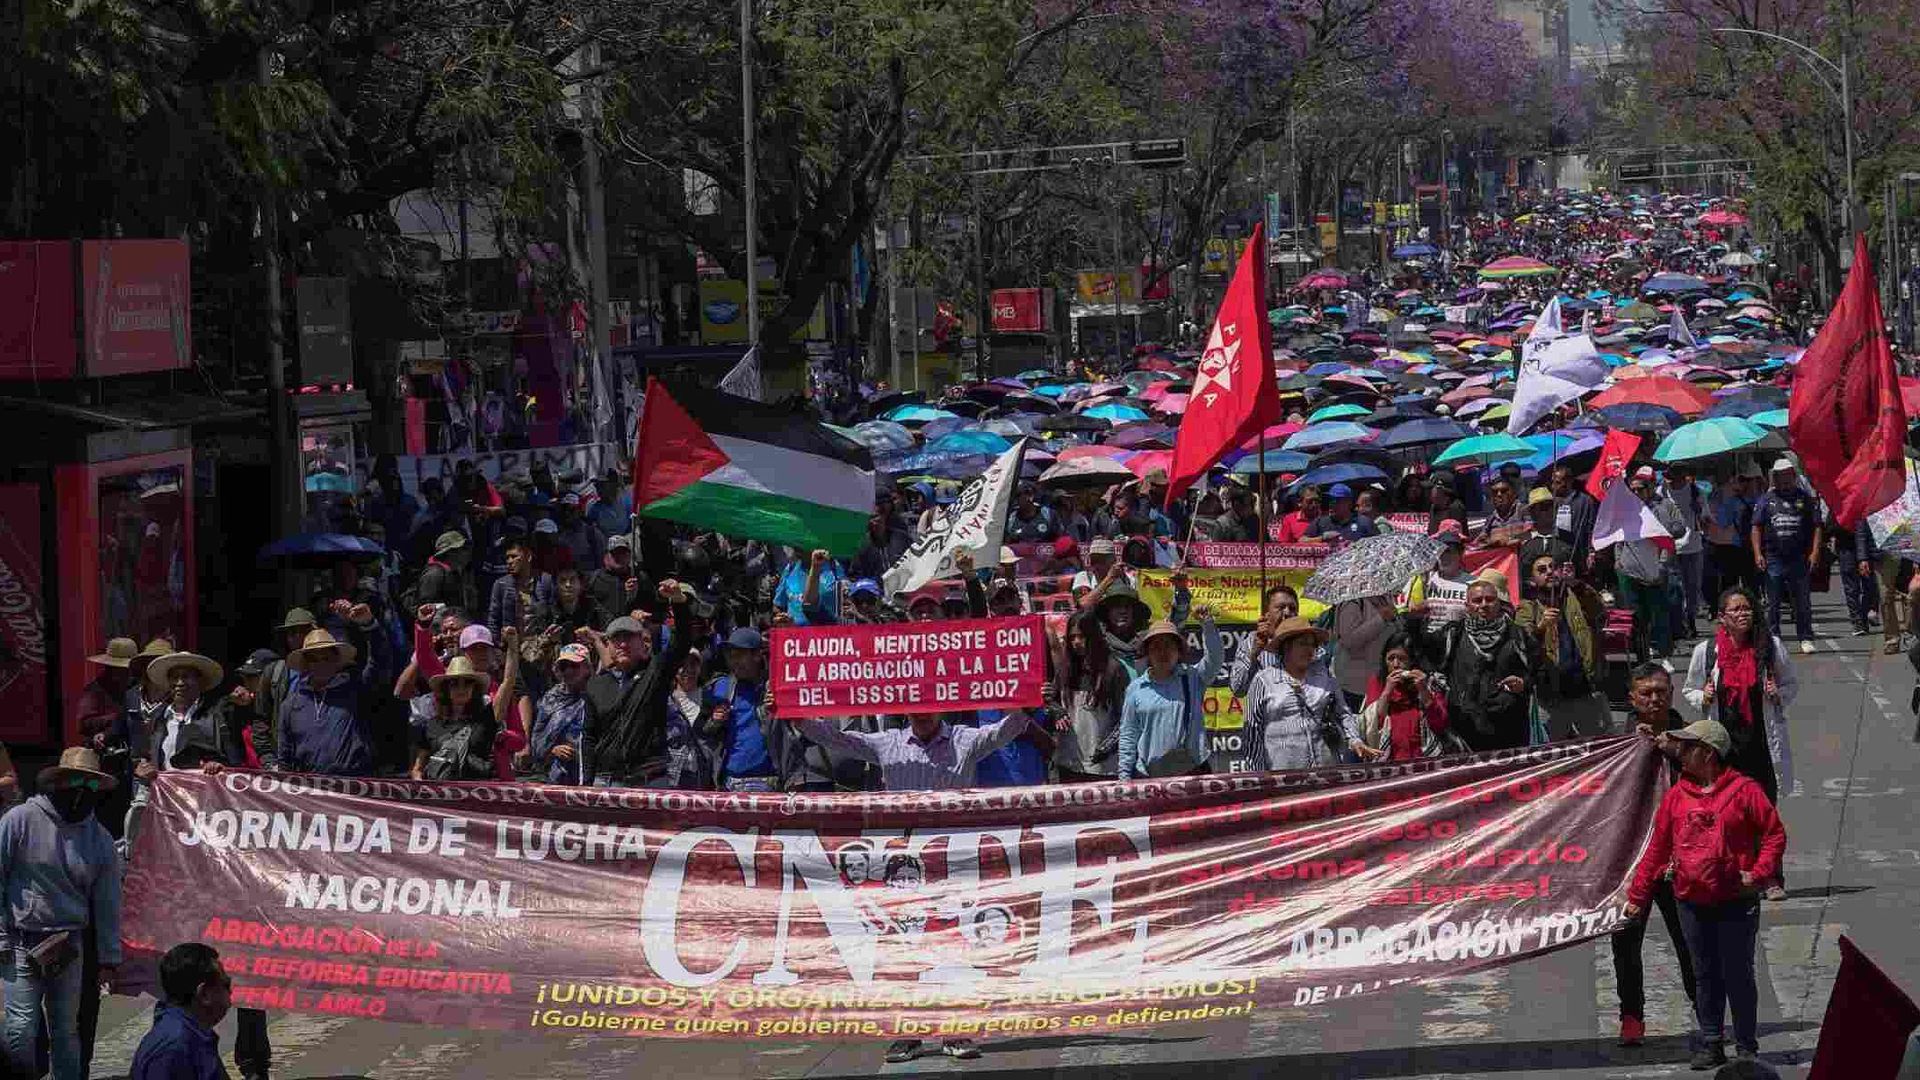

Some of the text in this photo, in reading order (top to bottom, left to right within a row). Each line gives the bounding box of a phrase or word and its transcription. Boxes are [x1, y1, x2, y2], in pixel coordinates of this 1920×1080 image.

[1142, 575, 1215, 588] Asalea
[783, 627, 1032, 658] CLAUDIA, MENTISSSTE CON
[784, 653, 1031, 682] LA ABROGACIÓN A LA LEY
[799, 679, 1019, 706] DEL ISSSTE DE 2007
[566, 787, 763, 813] NACIONAL
[177, 810, 648, 861] JORNADA DE LUCHA
[284, 871, 523, 919] NACIONAL
[640, 815, 1151, 988] CNTE
[203, 917, 385, 955] ABROGACIÓN
[253, 956, 368, 985] REFORMA
[375, 966, 512, 995] EDUCATIVA
[315, 992, 387, 1017] AMLO
[700, 988, 718, 1010] Y
[1293, 985, 1329, 1007] DE
[673, 1017, 750, 1034] quien
[758, 1014, 884, 1037] gobierne,
[893, 1013, 932, 1034] los
[939, 1012, 1062, 1034] derechos
[1069, 1012, 1098, 1029] se
[1106, 1001, 1255, 1027] defienden!
